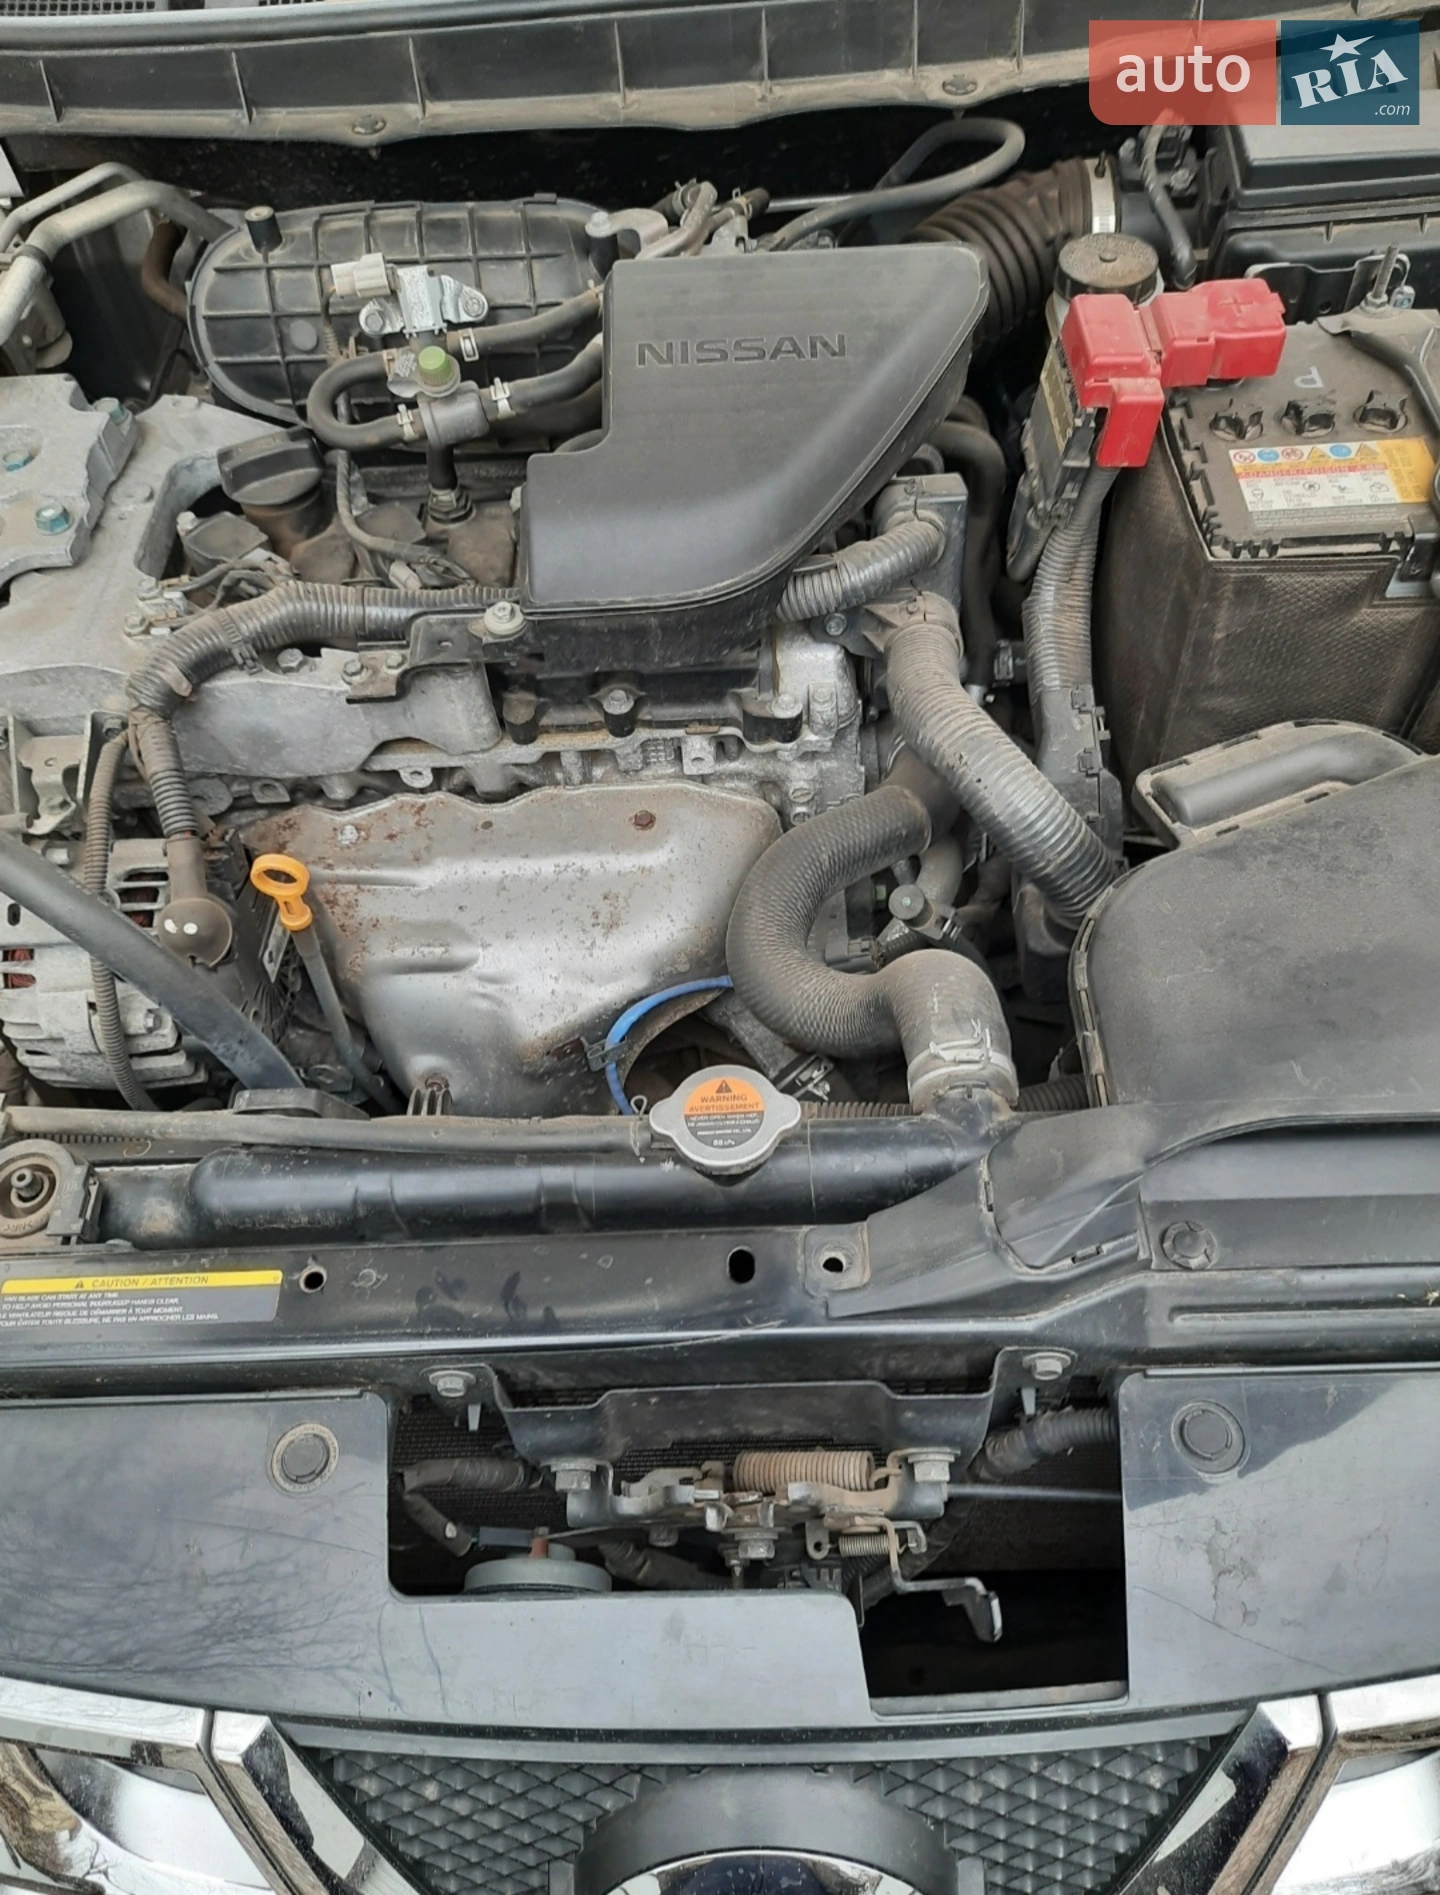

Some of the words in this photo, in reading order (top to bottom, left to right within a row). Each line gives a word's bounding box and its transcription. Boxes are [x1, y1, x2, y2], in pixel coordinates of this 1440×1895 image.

[636, 333, 848, 368] NISSAN
[700, 1093, 748, 1103] WARNING
[689, 1102, 759, 1112] AVERTISSEMENT
[91, 1278, 139, 1288] CAUTION
[150, 1275, 209, 1286] ATTENTION
